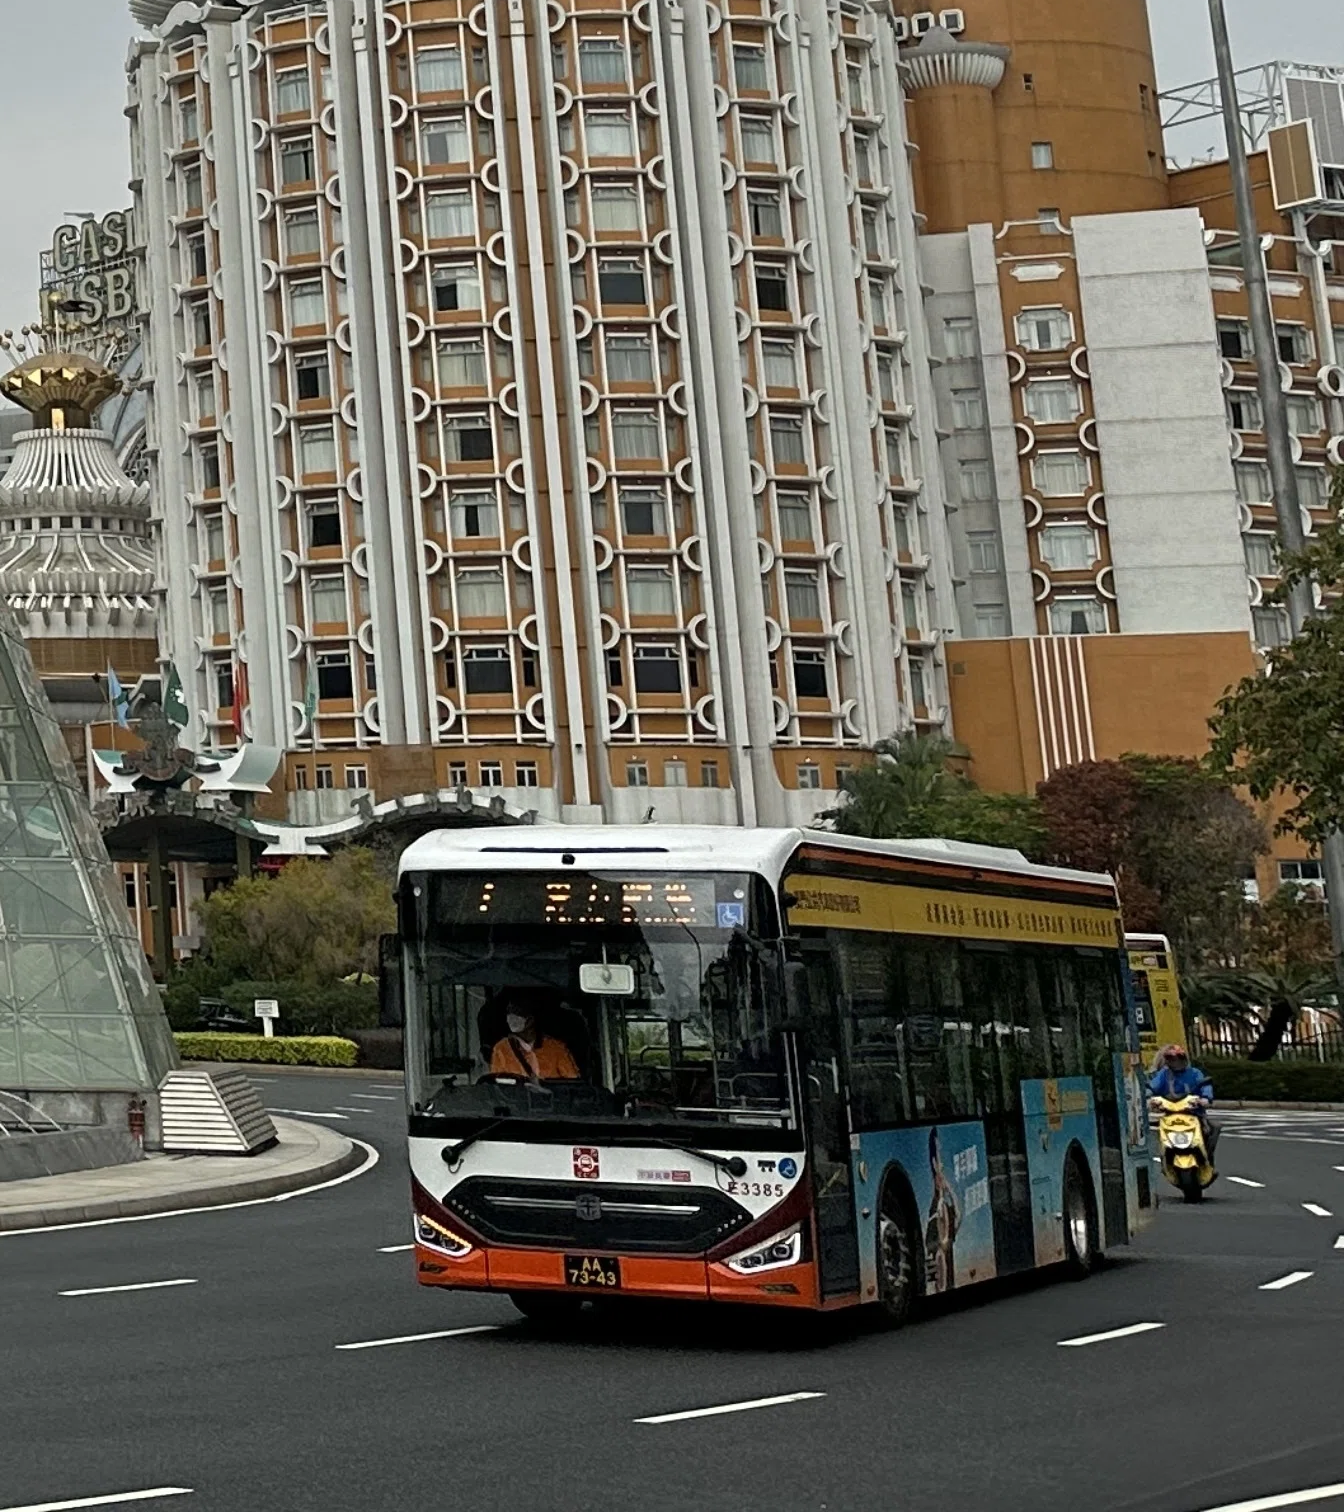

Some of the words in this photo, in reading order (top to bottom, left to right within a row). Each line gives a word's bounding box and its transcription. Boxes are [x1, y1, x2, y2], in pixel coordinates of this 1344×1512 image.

[727, 1181, 784, 1198] E3385
[582, 1257, 602, 1272] AA
[568, 1268, 616, 1286] 73-43
